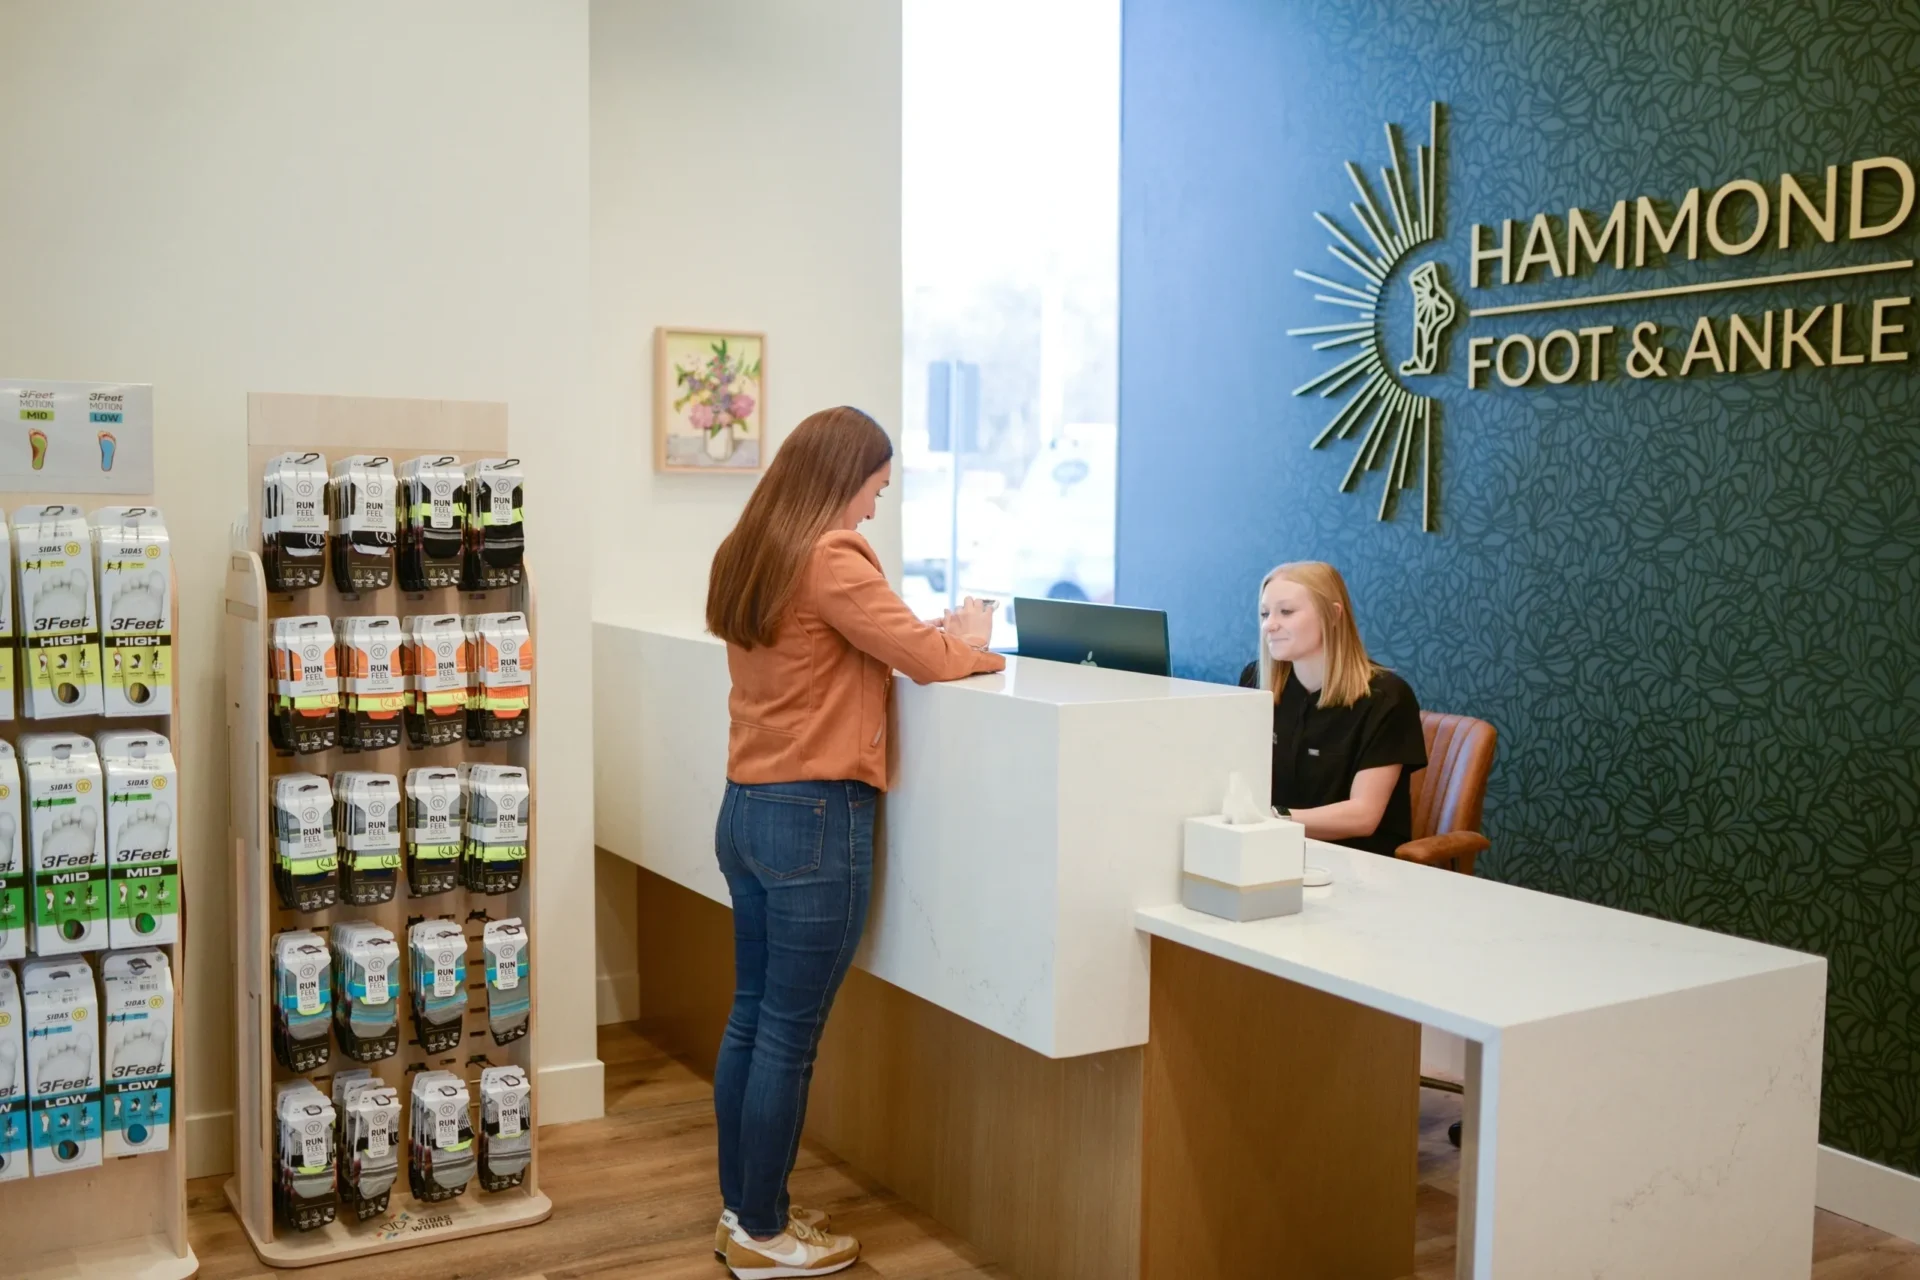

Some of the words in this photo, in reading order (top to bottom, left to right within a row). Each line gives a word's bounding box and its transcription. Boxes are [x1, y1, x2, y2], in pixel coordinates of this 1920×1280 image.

[1470, 156, 1915, 288] HAMMOND
[1468, 326, 1613, 390] FOOT
[1626, 321, 1667, 379] &
[1680, 297, 1911, 376] ANKLE
[20, 390, 55, 399] 3Feet
[89, 393, 124, 401] 3Feet
[20, 400, 54, 408] MOTION
[27, 412, 47, 420] MID
[94, 414, 119, 422] LOW
[366, 502, 383, 510] RUN
[366, 509, 382, 517] FEEL
[34, 616, 89, 631] 3Feet
[111, 618, 165, 630] 3Feet
[40, 635, 86, 647] HIGH
[116, 637, 160, 646] HIGH
[501, 658, 517, 666] RUN
[304, 665, 322, 673] RUN
[501, 665, 517, 673] FEEL
[305, 673, 323, 681] FEEL
[50, 783, 73, 791] SIDAS
[126, 779, 149, 787] SIDAS
[303, 828, 321, 836] RUN
[304, 835, 321, 843] FEEL
[116, 848, 171, 862] 3Feet
[42, 852, 98, 868] 3Feet
[126, 867, 162, 878] MID
[53, 872, 89, 884] MID
[438, 968, 454, 976] RUN
[300, 982, 316, 990] RUN
[46, 1012, 69, 1021] SIDAS
[112, 1063, 165, 1078] 3Feet
[38, 1076, 94, 1094] 3Feet
[118, 1080, 158, 1092] LOW
[45, 1094, 87, 1108] LOW
[502, 1108, 518, 1117] RUN
[439, 1119, 456, 1127] RUN
[372, 1128, 387, 1136] RUN
[306, 1137, 323, 1146] RUN
[307, 1145, 324, 1153] FEEL
[417, 1214, 451, 1225] SIDAS
[412, 1221, 453, 1232] WORLD
